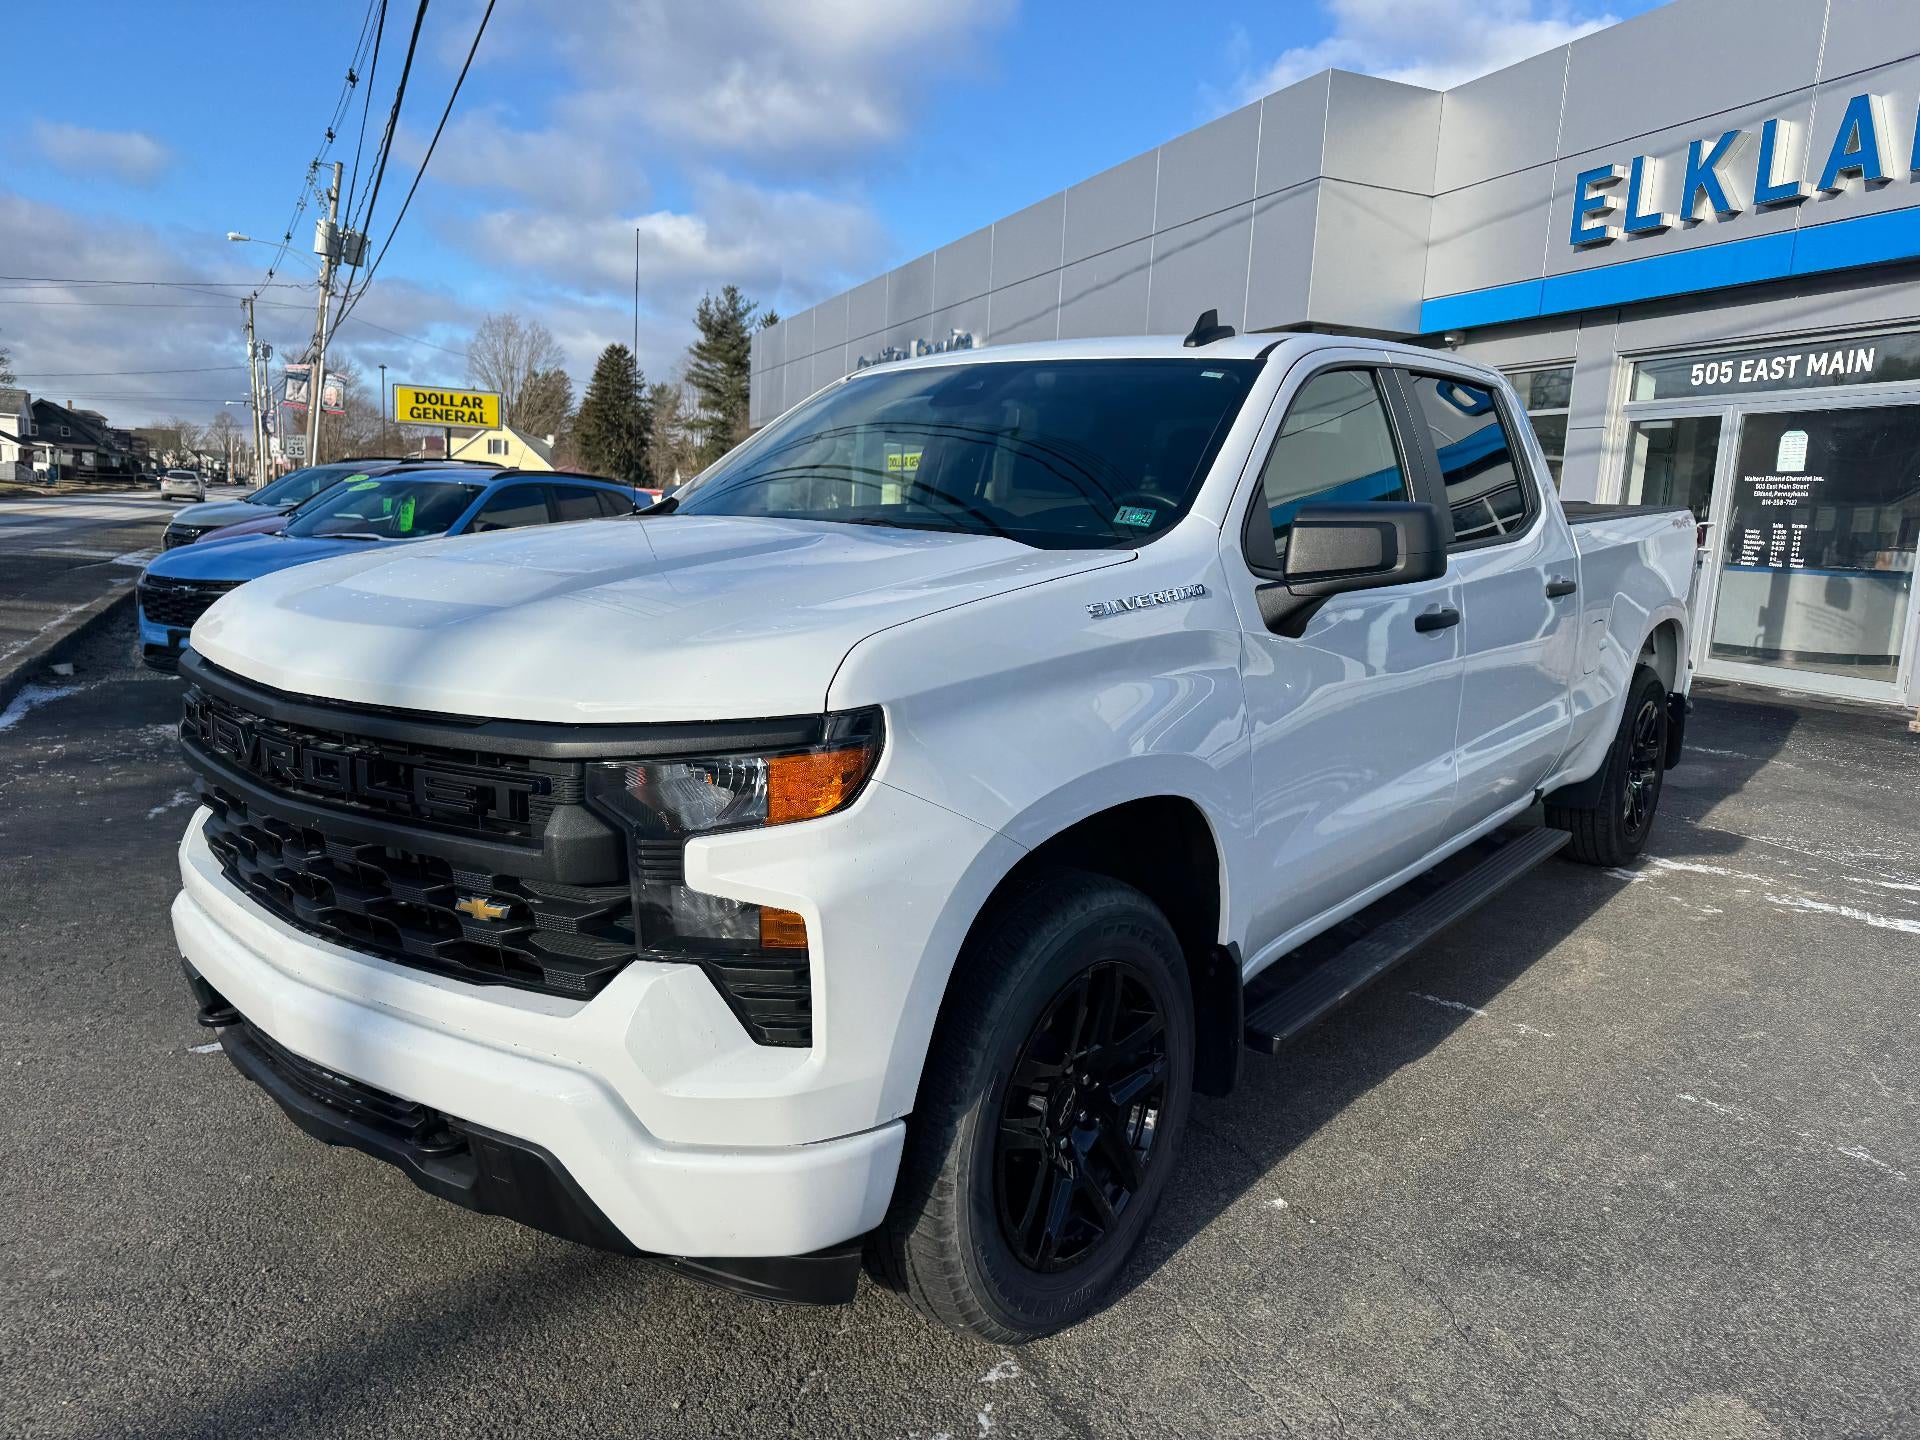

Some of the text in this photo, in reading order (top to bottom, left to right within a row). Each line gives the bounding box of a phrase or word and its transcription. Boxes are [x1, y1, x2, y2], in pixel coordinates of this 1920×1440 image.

[1569, 93, 1920, 246] ELKLA
[1690, 347, 1875, 386] 505 EAST MAIN
[413, 391, 484, 410] DOLLAR
[409, 406, 488, 425] GENERAL
[288, 446, 305, 456] 35
